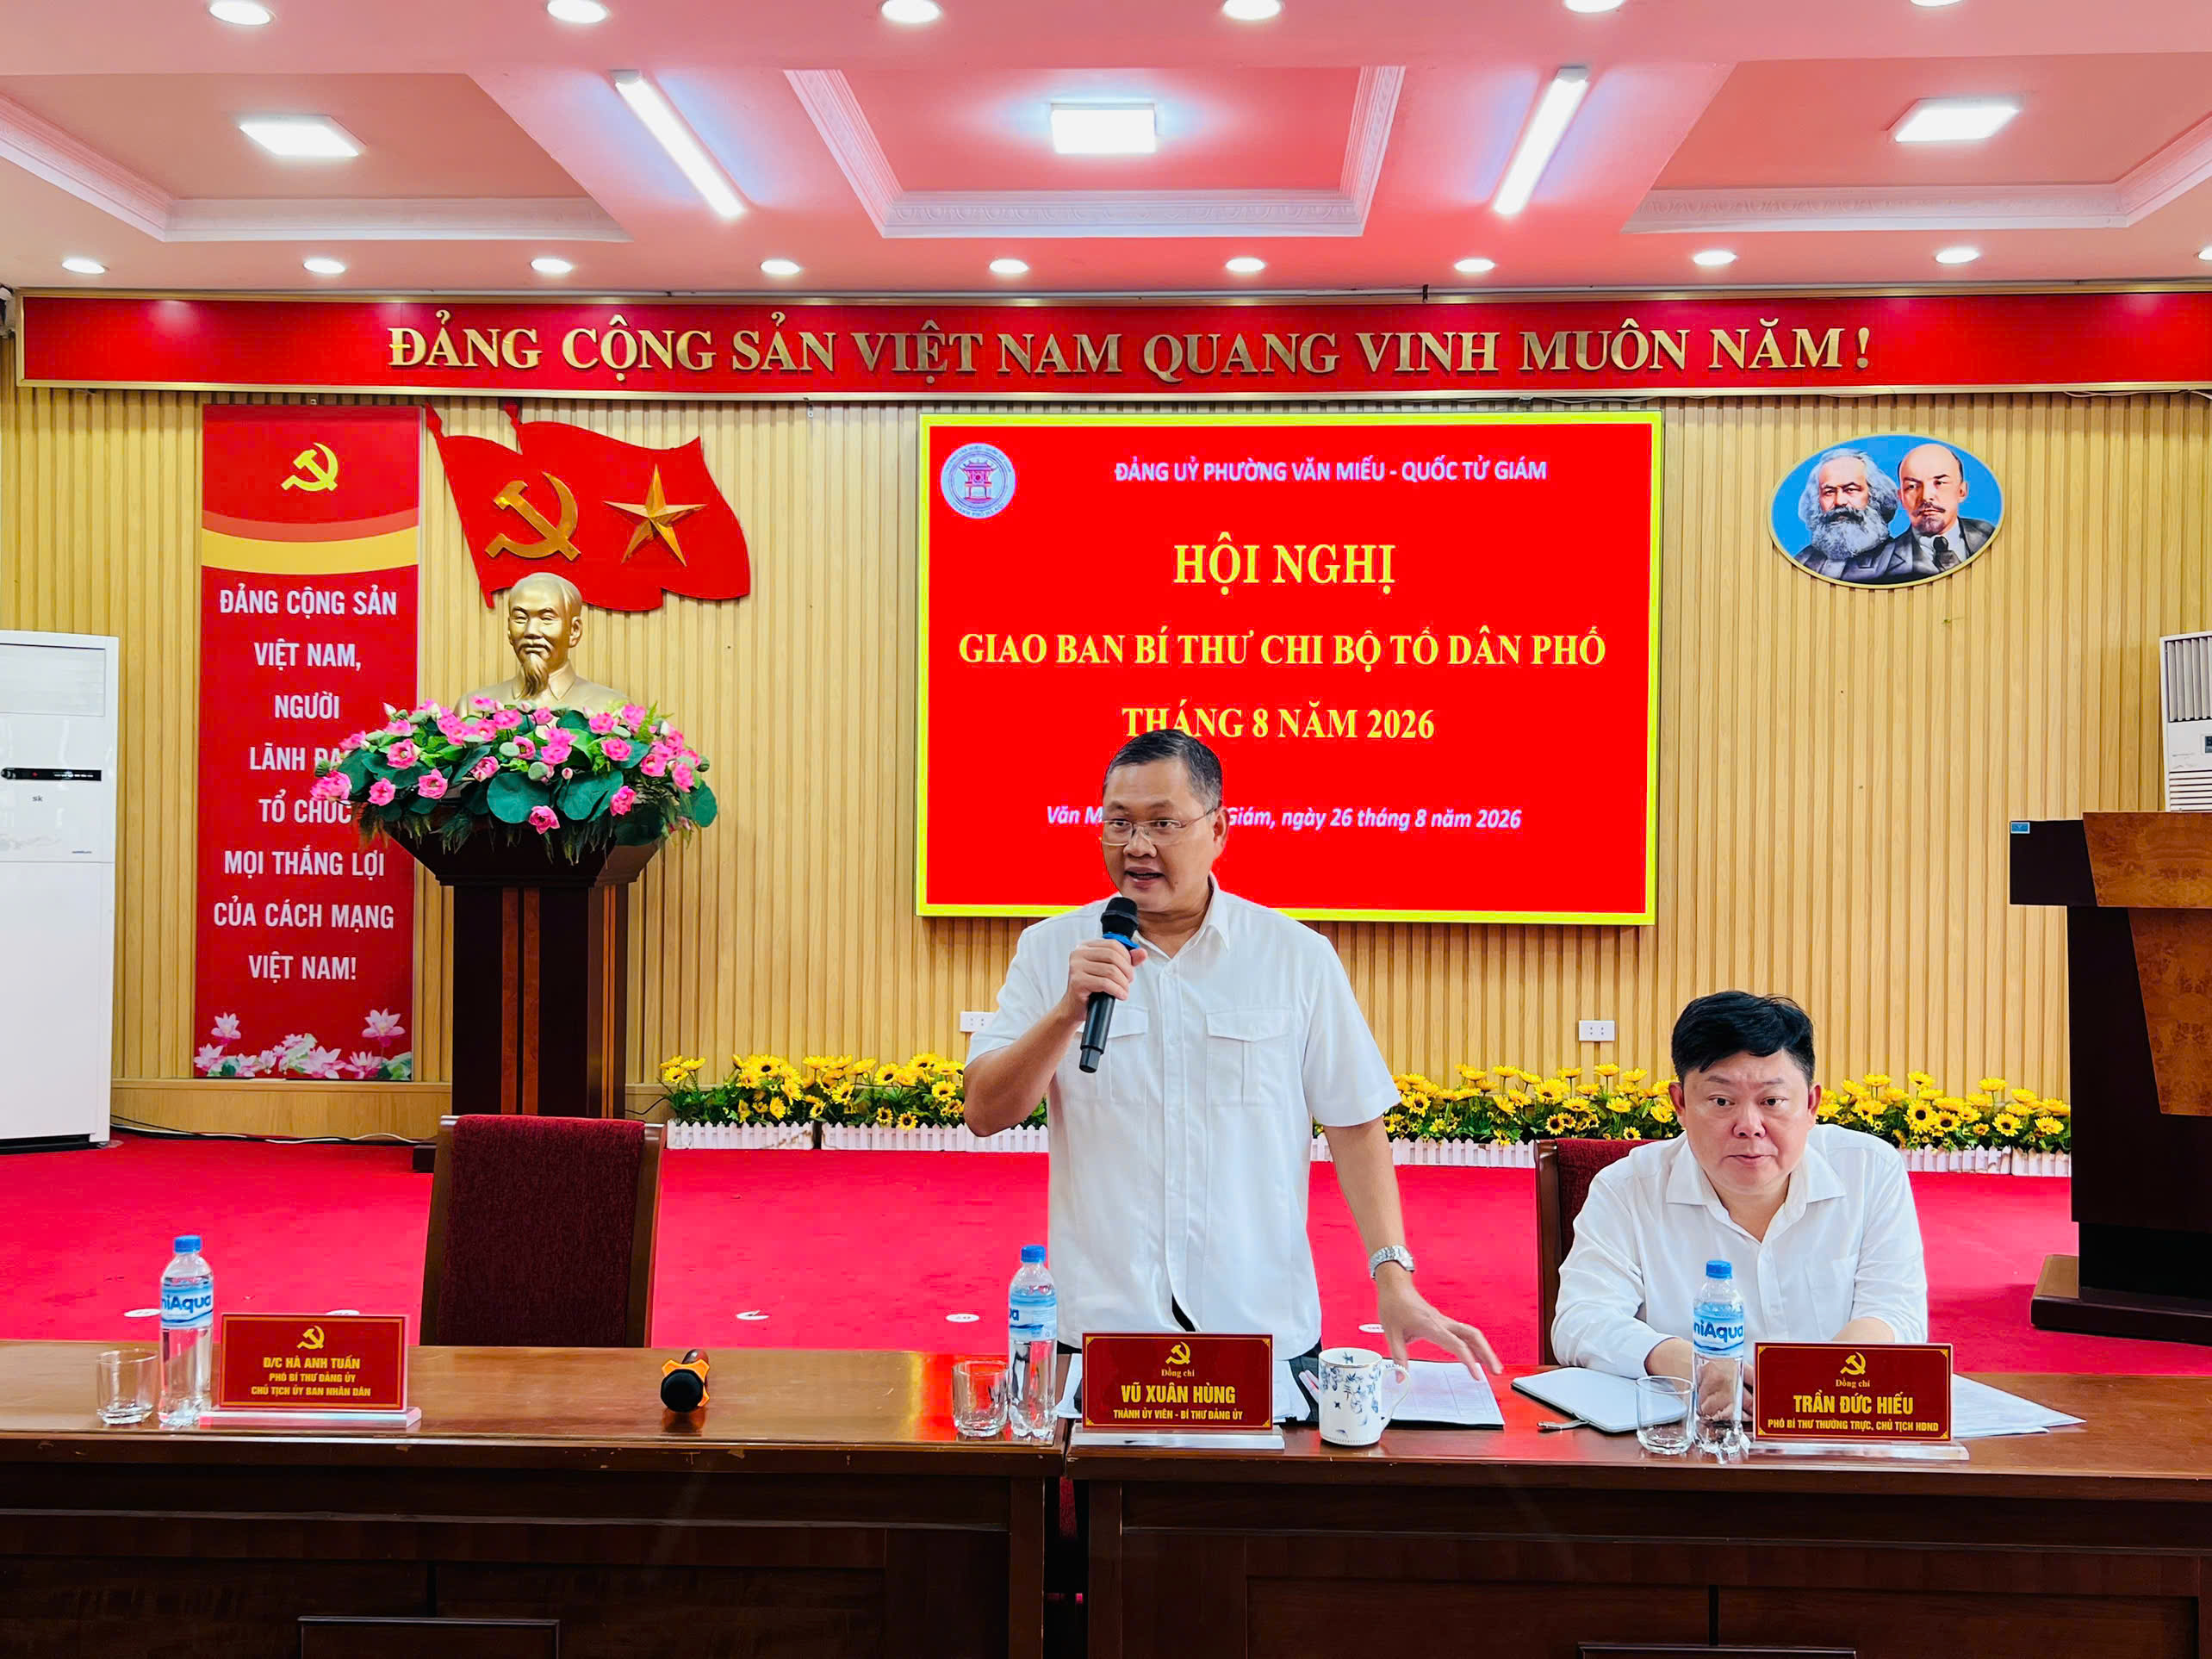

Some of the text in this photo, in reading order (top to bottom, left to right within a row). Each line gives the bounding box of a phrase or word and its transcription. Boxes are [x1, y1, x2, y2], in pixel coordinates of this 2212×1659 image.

[388, 309, 540, 369] ĐẢNG
[562, 314, 714, 382] CỘNG
[732, 312, 836, 372] SẢN
[851, 320, 982, 384] VIỆT
[995, 333, 1123, 373] NAM
[1143, 332, 1340, 382] QUANG
[1355, 332, 1500, 373] VINH
[1519, 318, 1689, 371] MUÔN
[1115, 456, 1169, 482] ĐẢNG
[1204, 457, 1286, 481] PHƯỜNG
[1292, 457, 1330, 480] VĂN
[1336, 455, 1385, 481] MIẾU
[1401, 455, 1457, 482] QUỐC
[1462, 455, 1490, 480] TỬ
[1494, 456, 1547, 480] GIÁM
[1173, 531, 1395, 595] HỘI NGHỊ
[220, 583, 396, 619] ĐẢNG CỘNG SẢN
[253, 638, 362, 672] VIỆT NAM,
[959, 633, 1047, 663] GIAO
[1056, 635, 1125, 663] BAN
[1134, 625, 1169, 664] BÍ
[1177, 630, 1255, 664] THƯ
[1260, 635, 1324, 665] CHI
[1333, 631, 1382, 673] BỘ
[1447, 624, 1521, 665] DÂN
[1531, 625, 1606, 665] PHỐ
[274, 692, 339, 718] NGƯỜI
[1122, 699, 1434, 739] THÁNG 8 NĂM 2026
[249, 743, 306, 771] LÃNH
[258, 789, 286, 823] TỔ
[1047, 805, 1079, 824] Văn
[1282, 807, 1327, 830] ngày
[1330, 808, 1353, 827] 26
[1358, 808, 1410, 831] tháng
[1414, 809, 1427, 828] 8
[1431, 809, 1471, 828] năm
[1476, 809, 1522, 829] 2026
[225, 845, 384, 881] MỌI THẮNG LỢI
[214, 896, 394, 933] CỦA CÁCH MẠNG
[248, 951, 357, 984] VIỆT NAM!
[304, 1358, 327, 1369] ANH
[331, 1355, 360, 1369] TUẤN
[1121, 1382, 1235, 1404] VŨ XUÂN HÙNG
[1793, 1389, 1914, 1414] TRẦN ĐỨC HIẾU
[1113, 1407, 1140, 1419] THÀNH
[1154, 1407, 1173, 1419] VIÊN
[1180, 1408, 1189, 1419] BÍ
[1190, 1408, 1208, 1420] THƯ
[1208, 1407, 1230, 1420] ĐẢNG
